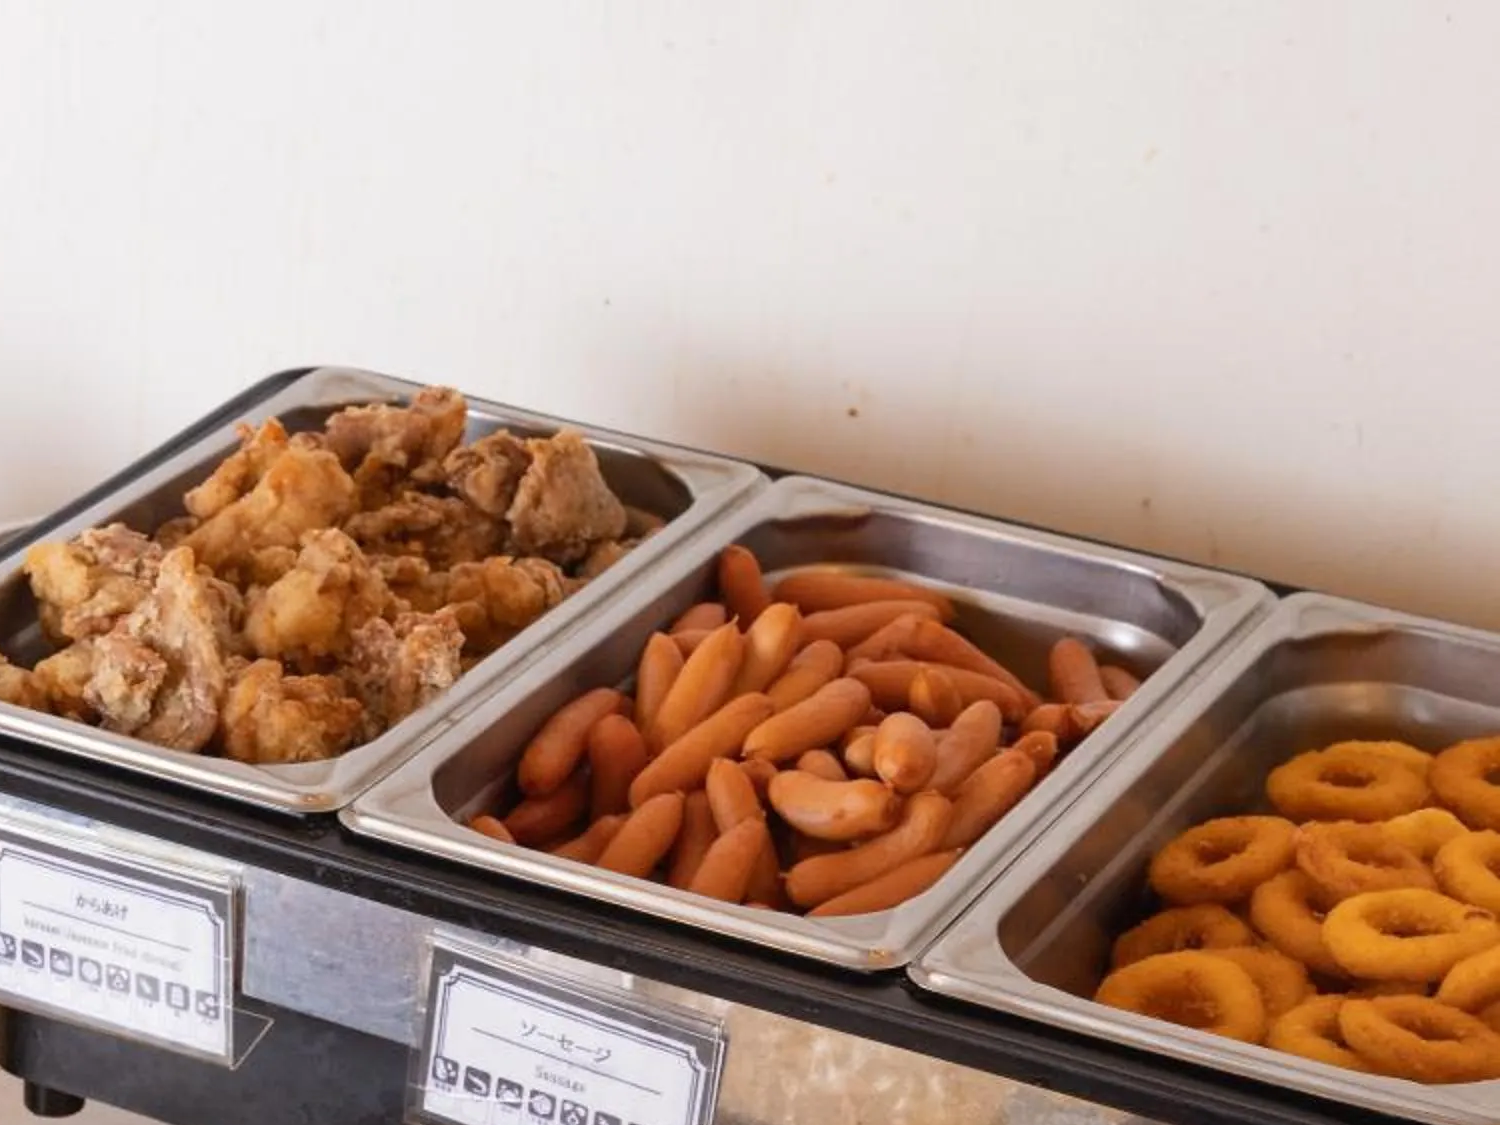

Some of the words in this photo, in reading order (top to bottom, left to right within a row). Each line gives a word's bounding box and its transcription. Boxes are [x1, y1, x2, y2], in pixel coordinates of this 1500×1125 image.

[520, 1019, 613, 1064] ソーセージ
